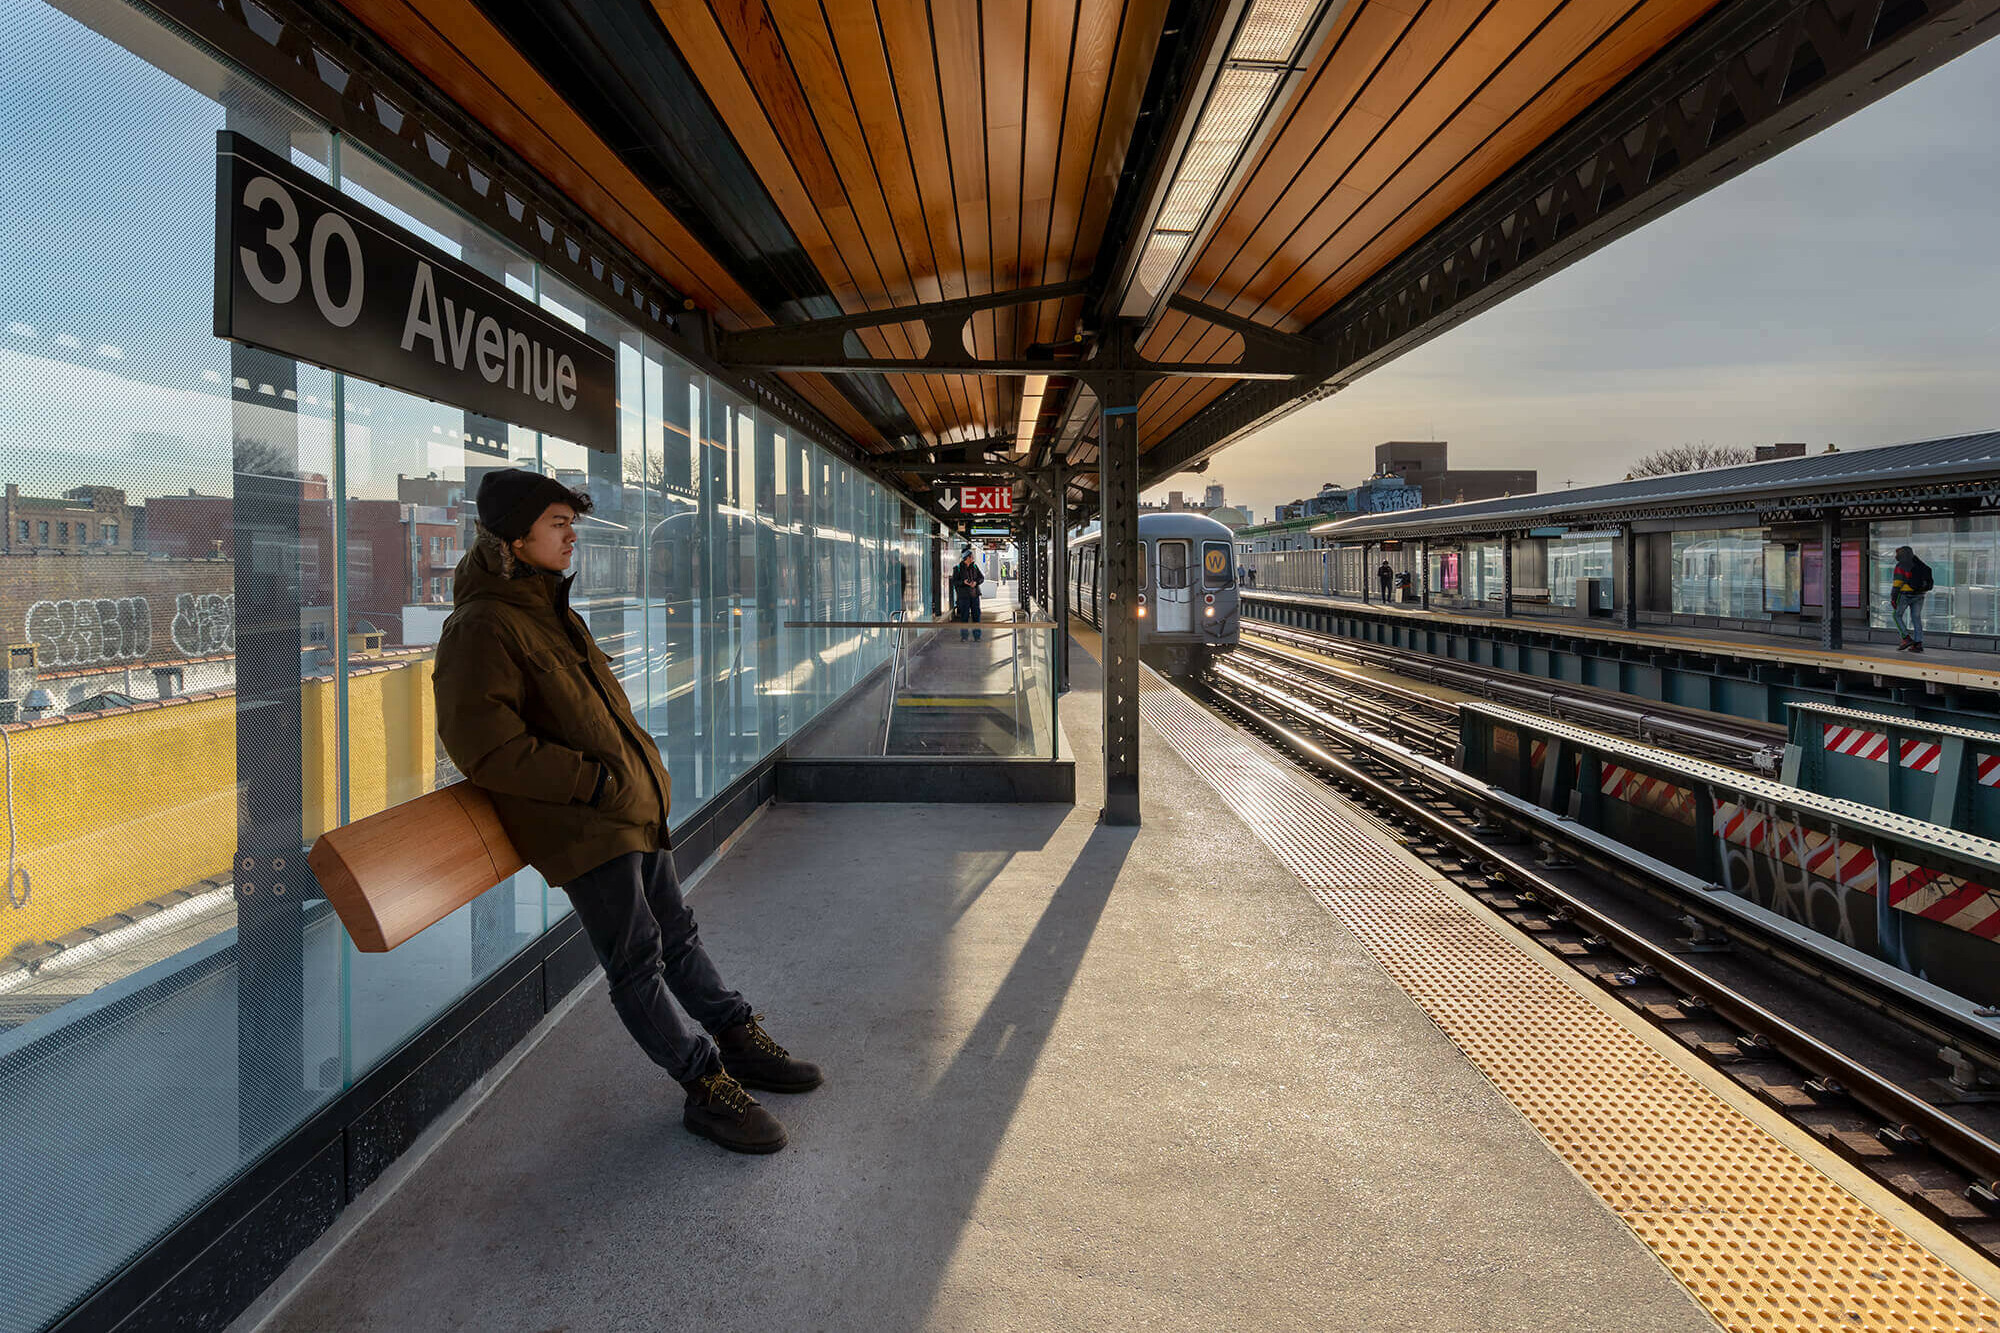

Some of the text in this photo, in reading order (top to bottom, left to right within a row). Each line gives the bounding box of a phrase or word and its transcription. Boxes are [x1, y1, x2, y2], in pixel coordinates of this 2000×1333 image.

[239, 176, 578, 411] 30 Avenue
[961, 487, 1011, 509] Exit
[1207, 555, 1224, 570] W
